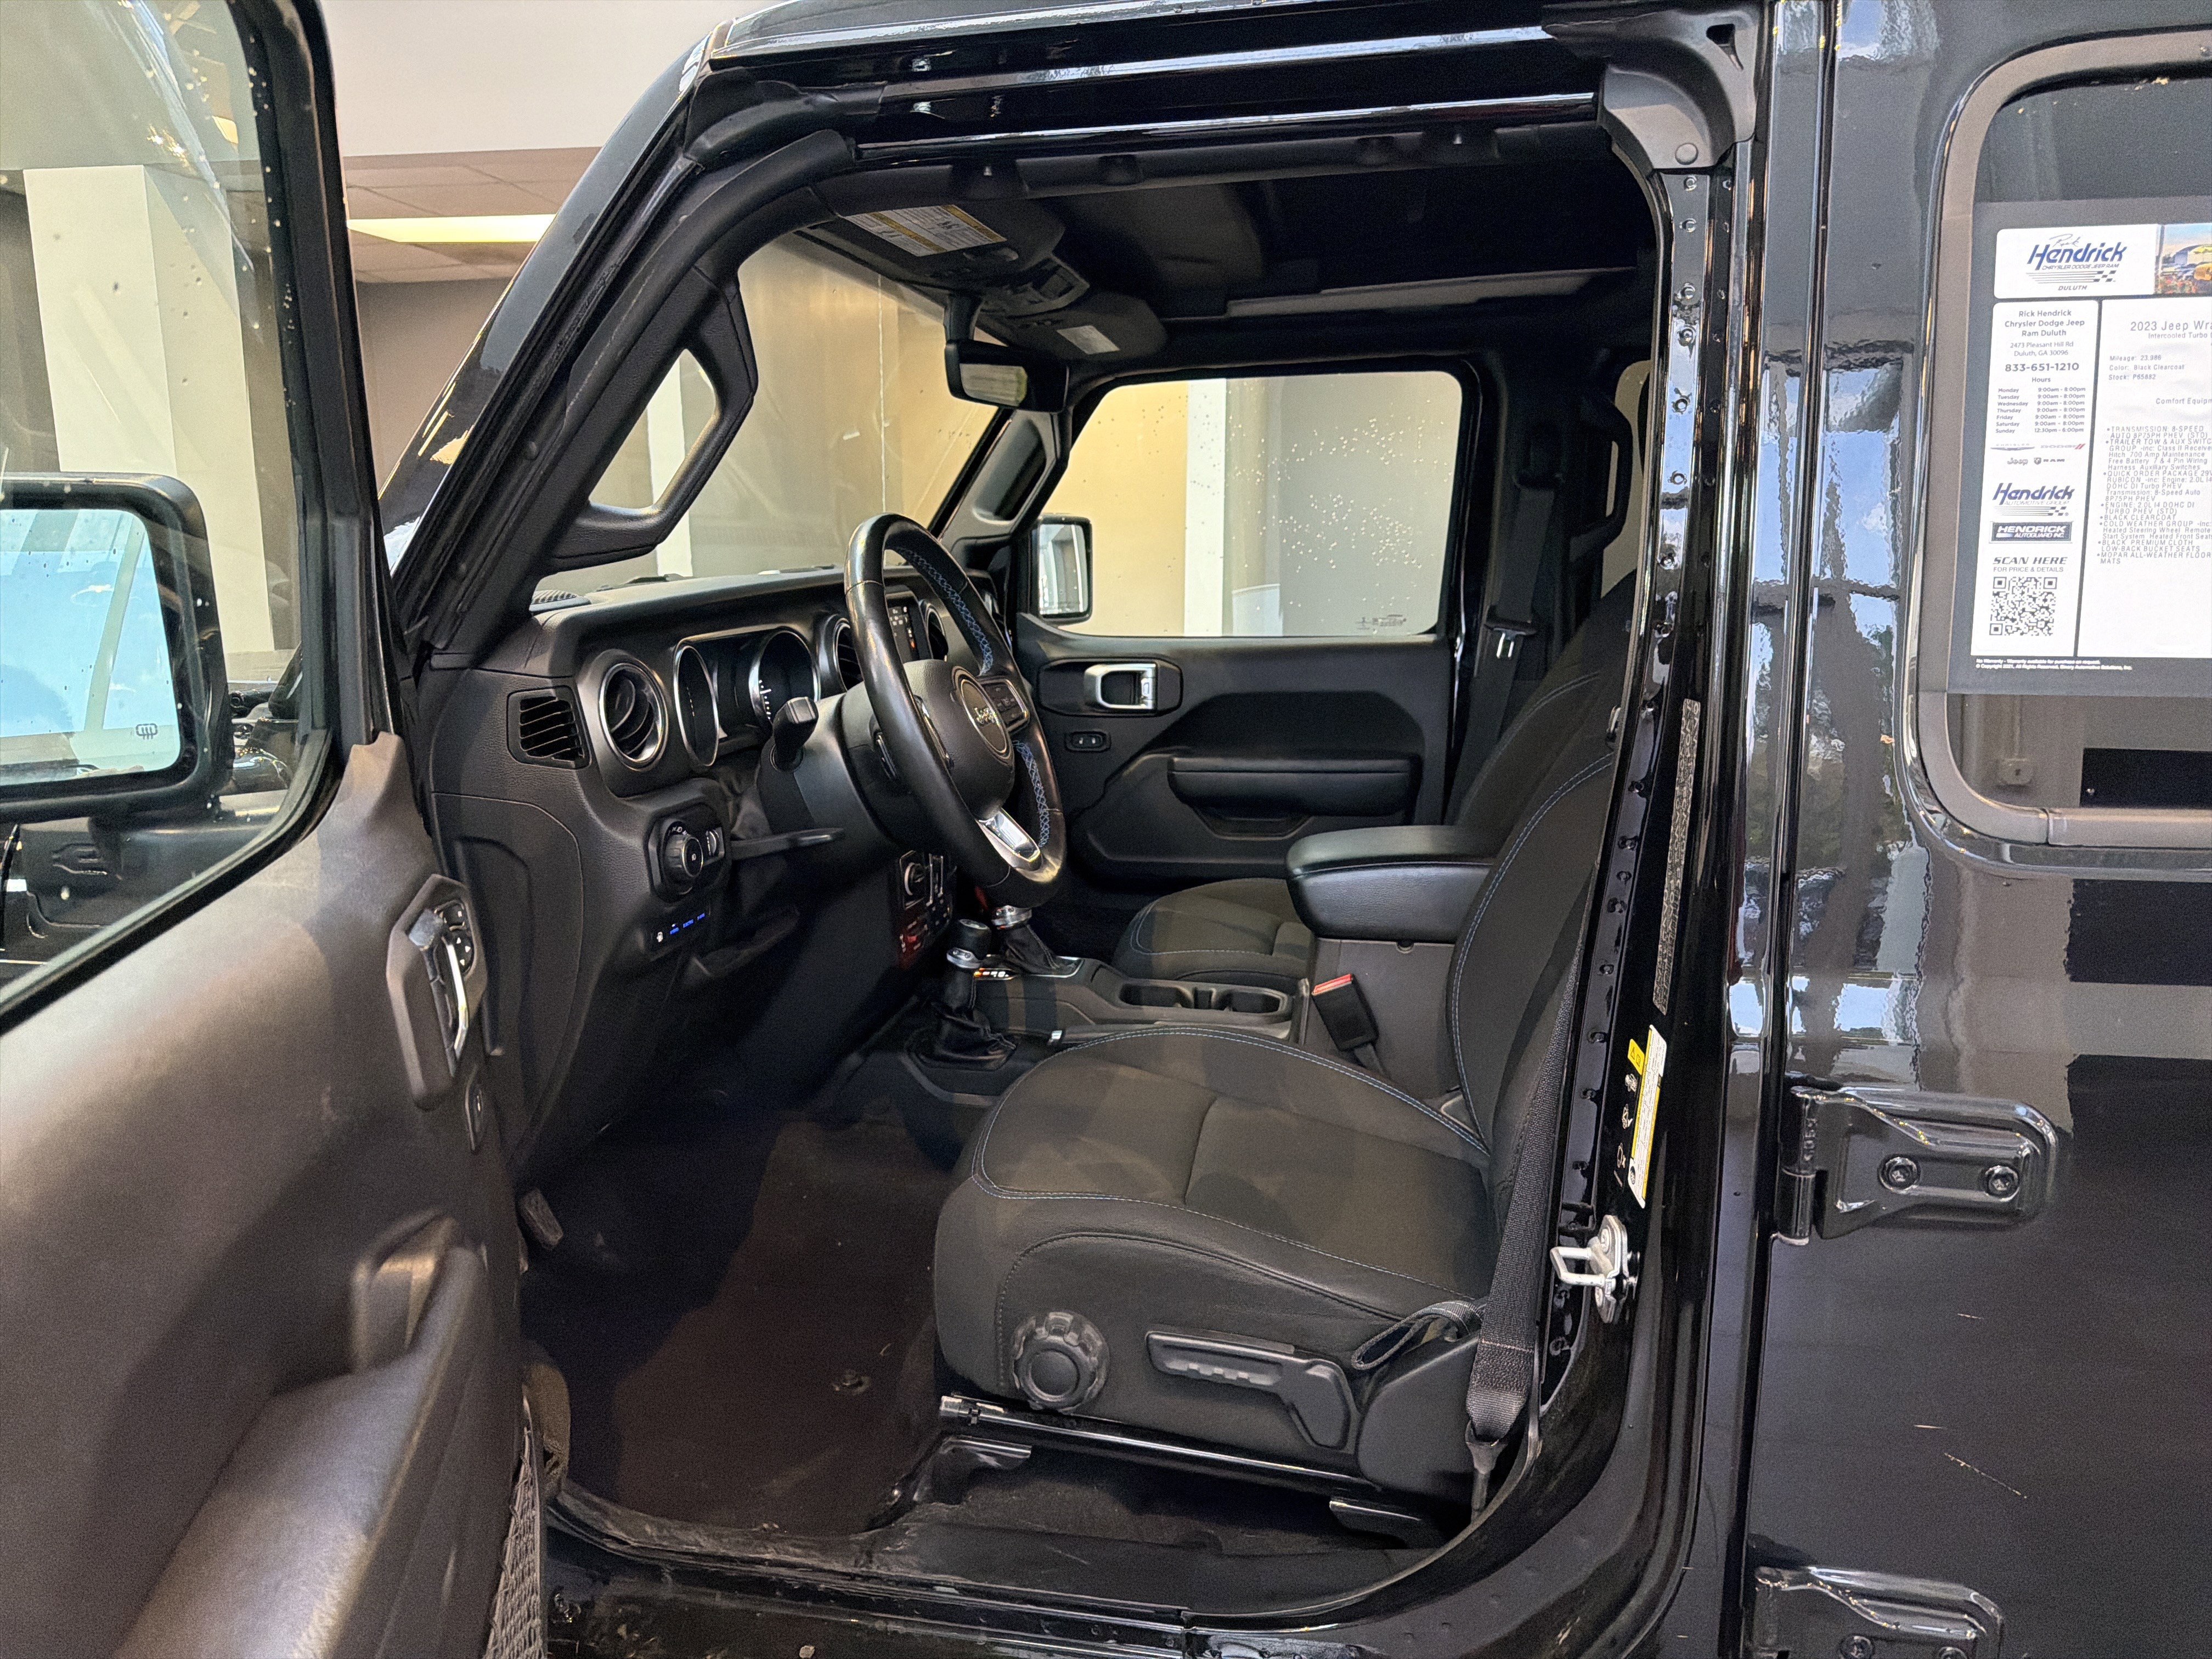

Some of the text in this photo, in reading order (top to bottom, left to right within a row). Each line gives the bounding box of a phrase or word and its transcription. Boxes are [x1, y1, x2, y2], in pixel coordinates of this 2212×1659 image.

[2027, 242, 2127, 270] Hendrick
[2130, 321, 2157, 331] 2023
[2162, 321, 2188, 331] Jeep
[2005, 363, 2079, 371] 833-651-1210
[1993, 483, 2075, 505] Hendrick
